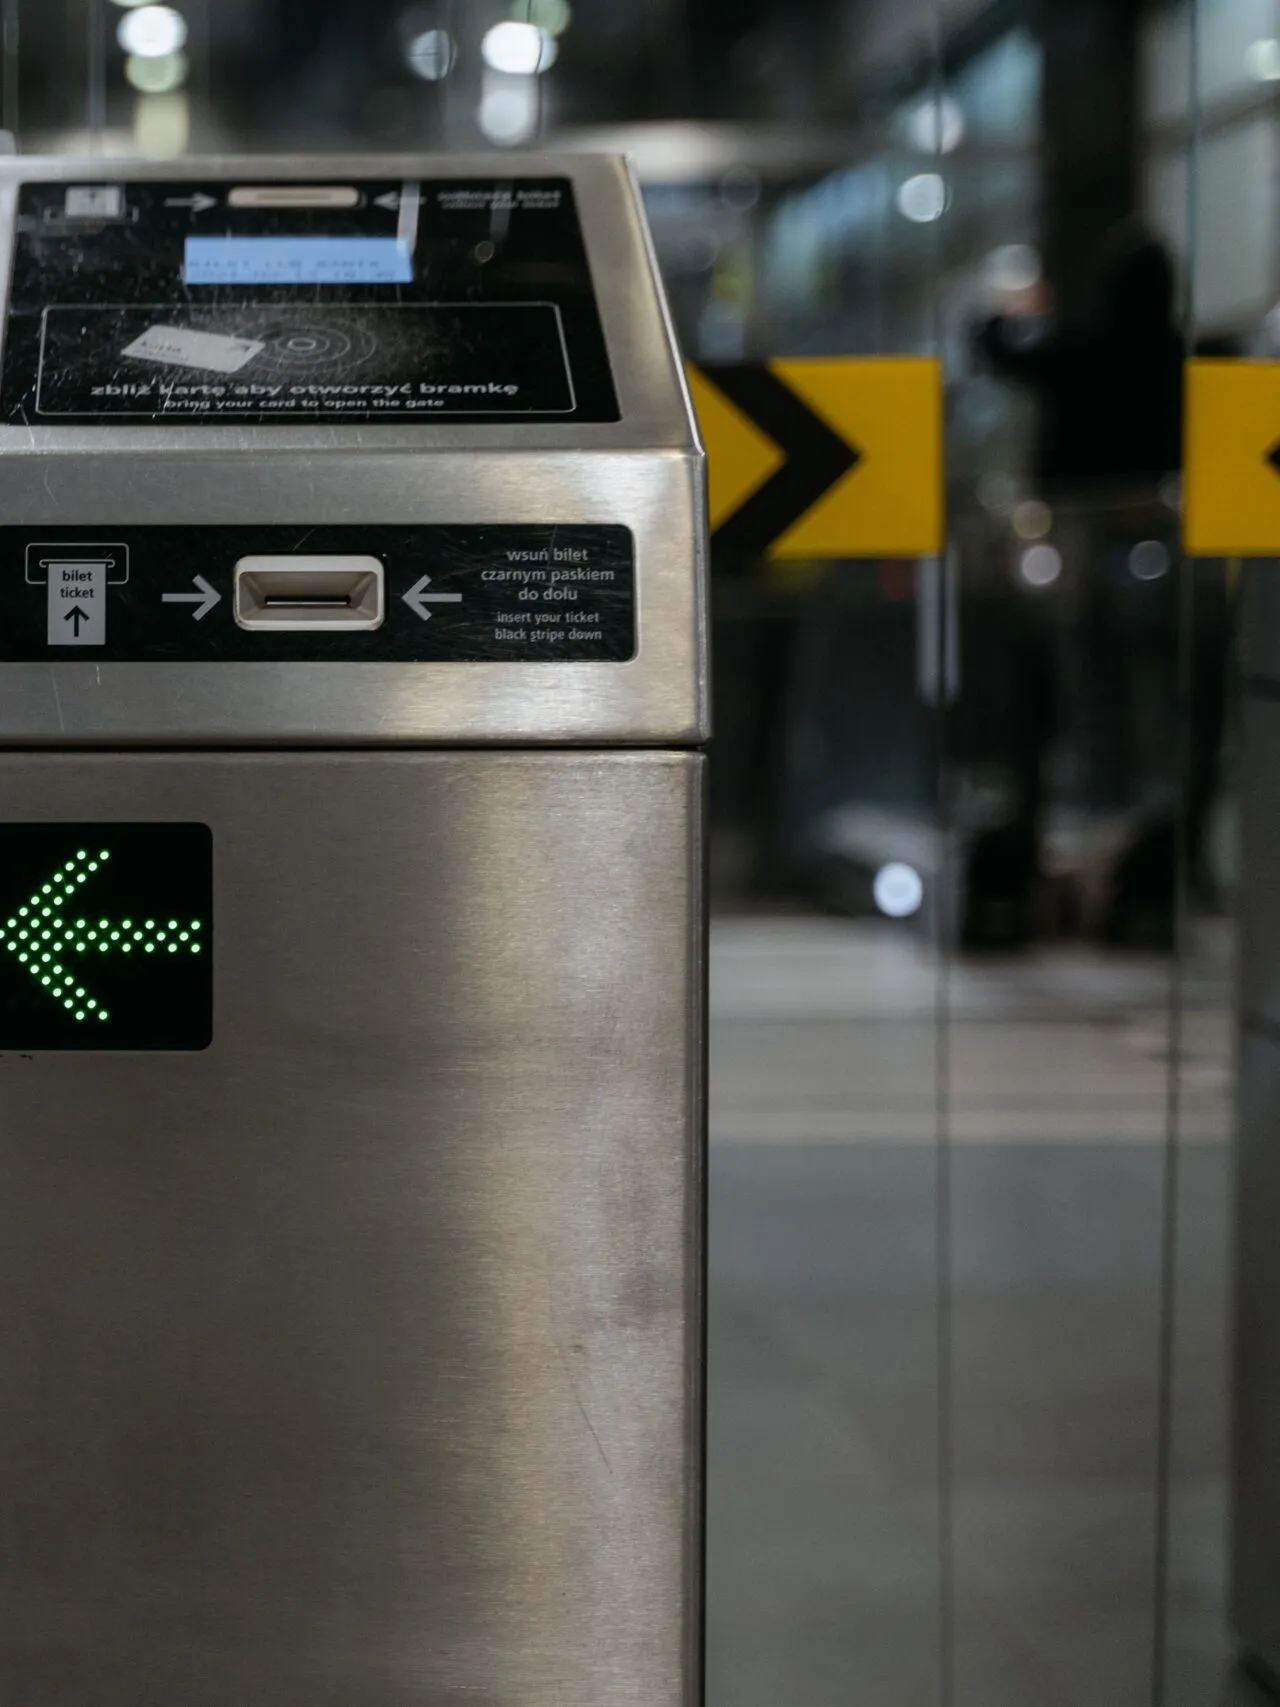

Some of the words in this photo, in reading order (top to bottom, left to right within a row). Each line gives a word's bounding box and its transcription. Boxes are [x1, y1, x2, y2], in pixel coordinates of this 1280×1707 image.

[159, 383, 226, 397] kartę
[234, 383, 282, 397] aby
[289, 382, 412, 396] otworzyć
[419, 382, 519, 396] bramkę
[165, 399, 210, 409] bring
[216, 401, 253, 409] your
[259, 399, 295, 408] card
[301, 400, 319, 408] to
[324, 401, 367, 409] open
[372, 399, 400, 408] the
[405, 400, 445, 409] gate
[506, 548, 549, 561] wsuń
[553, 547, 589, 561] bilet
[61, 569, 93, 582] bilet
[480, 570, 547, 584] czarnym
[550, 567, 615, 585] paskiem
[60, 586, 95, 599] ticket
[518, 587, 540, 601] do
[543, 586, 579, 601] dołu
[496, 611, 531, 623] insert
[534, 614, 561, 625] your
[565, 611, 600, 623] ticket
[494, 628, 528, 640] black
[530, 628, 566, 643] stripe
[568, 628, 603, 640] down
